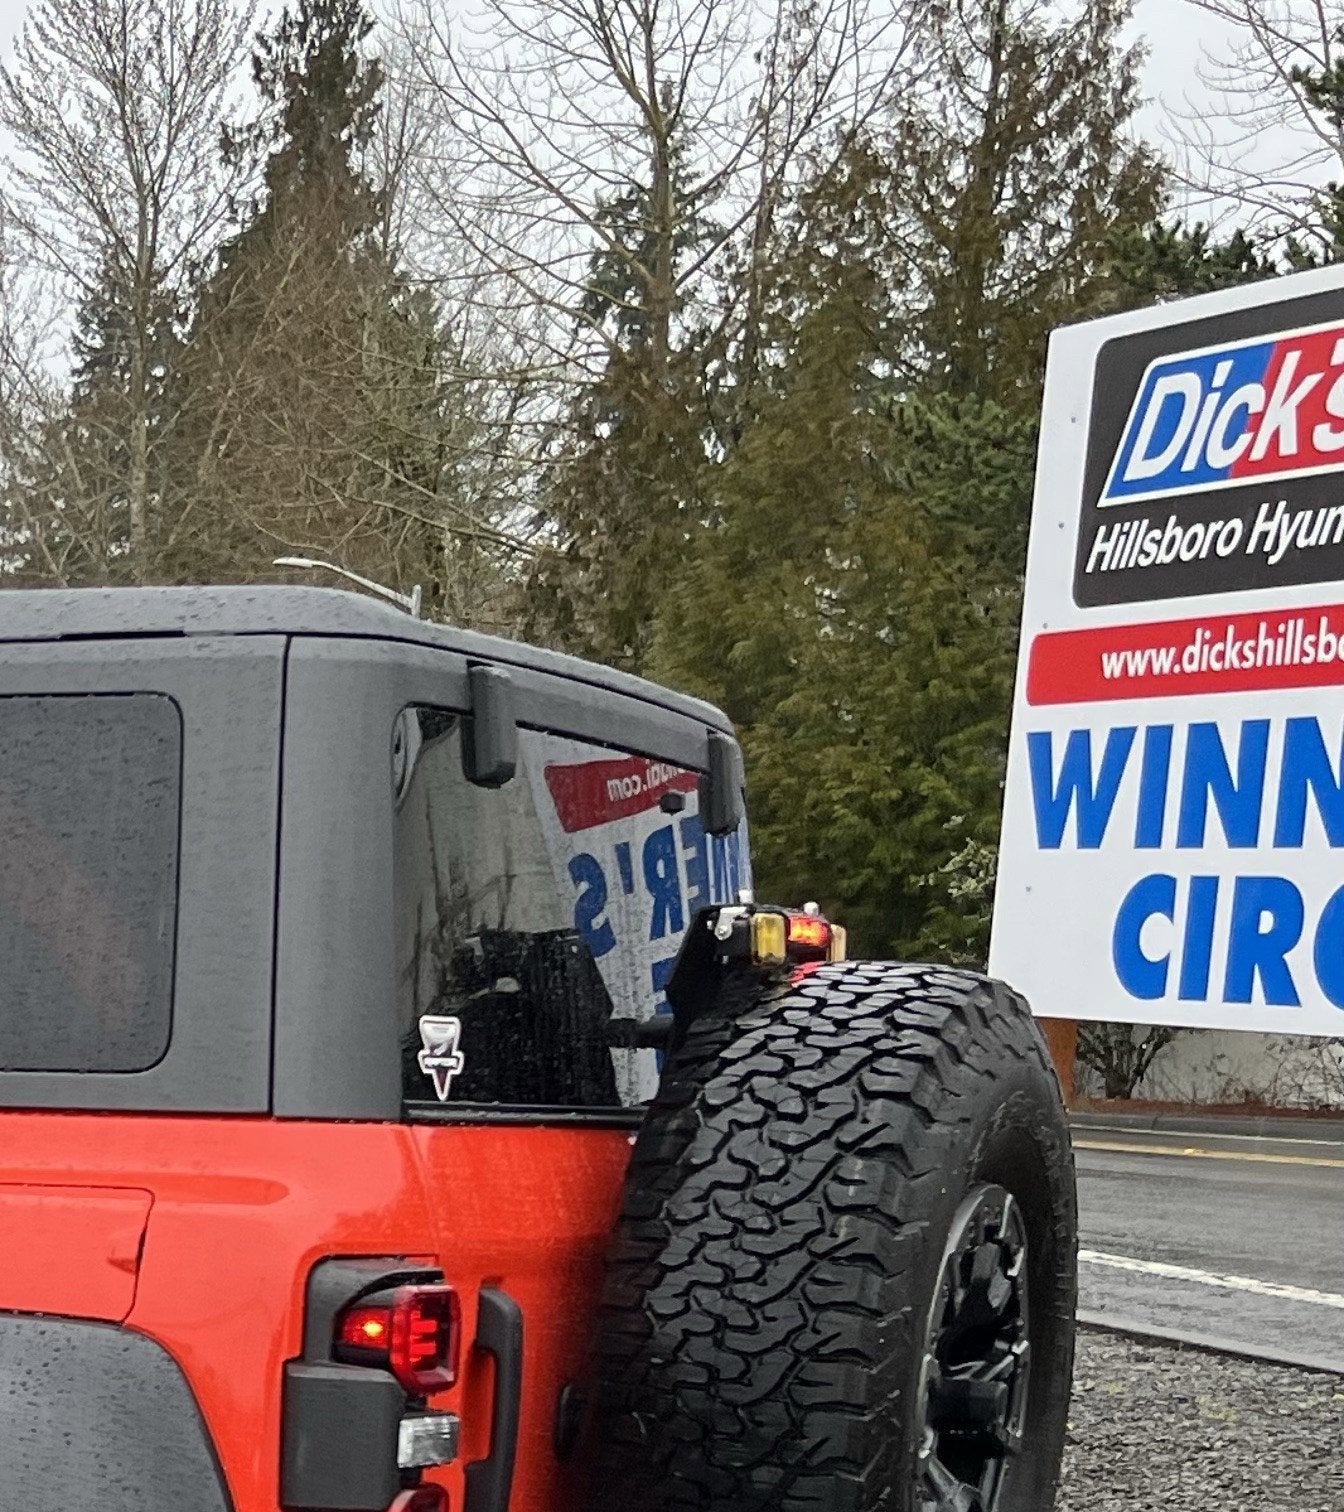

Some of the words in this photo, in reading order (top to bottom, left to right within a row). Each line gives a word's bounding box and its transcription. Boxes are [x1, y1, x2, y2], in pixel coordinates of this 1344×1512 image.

[1085, 515, 1243, 574] Hillsboro
[1245, 500, 1344, 565] Hyun
[1026, 716, 1344, 850] WINN
